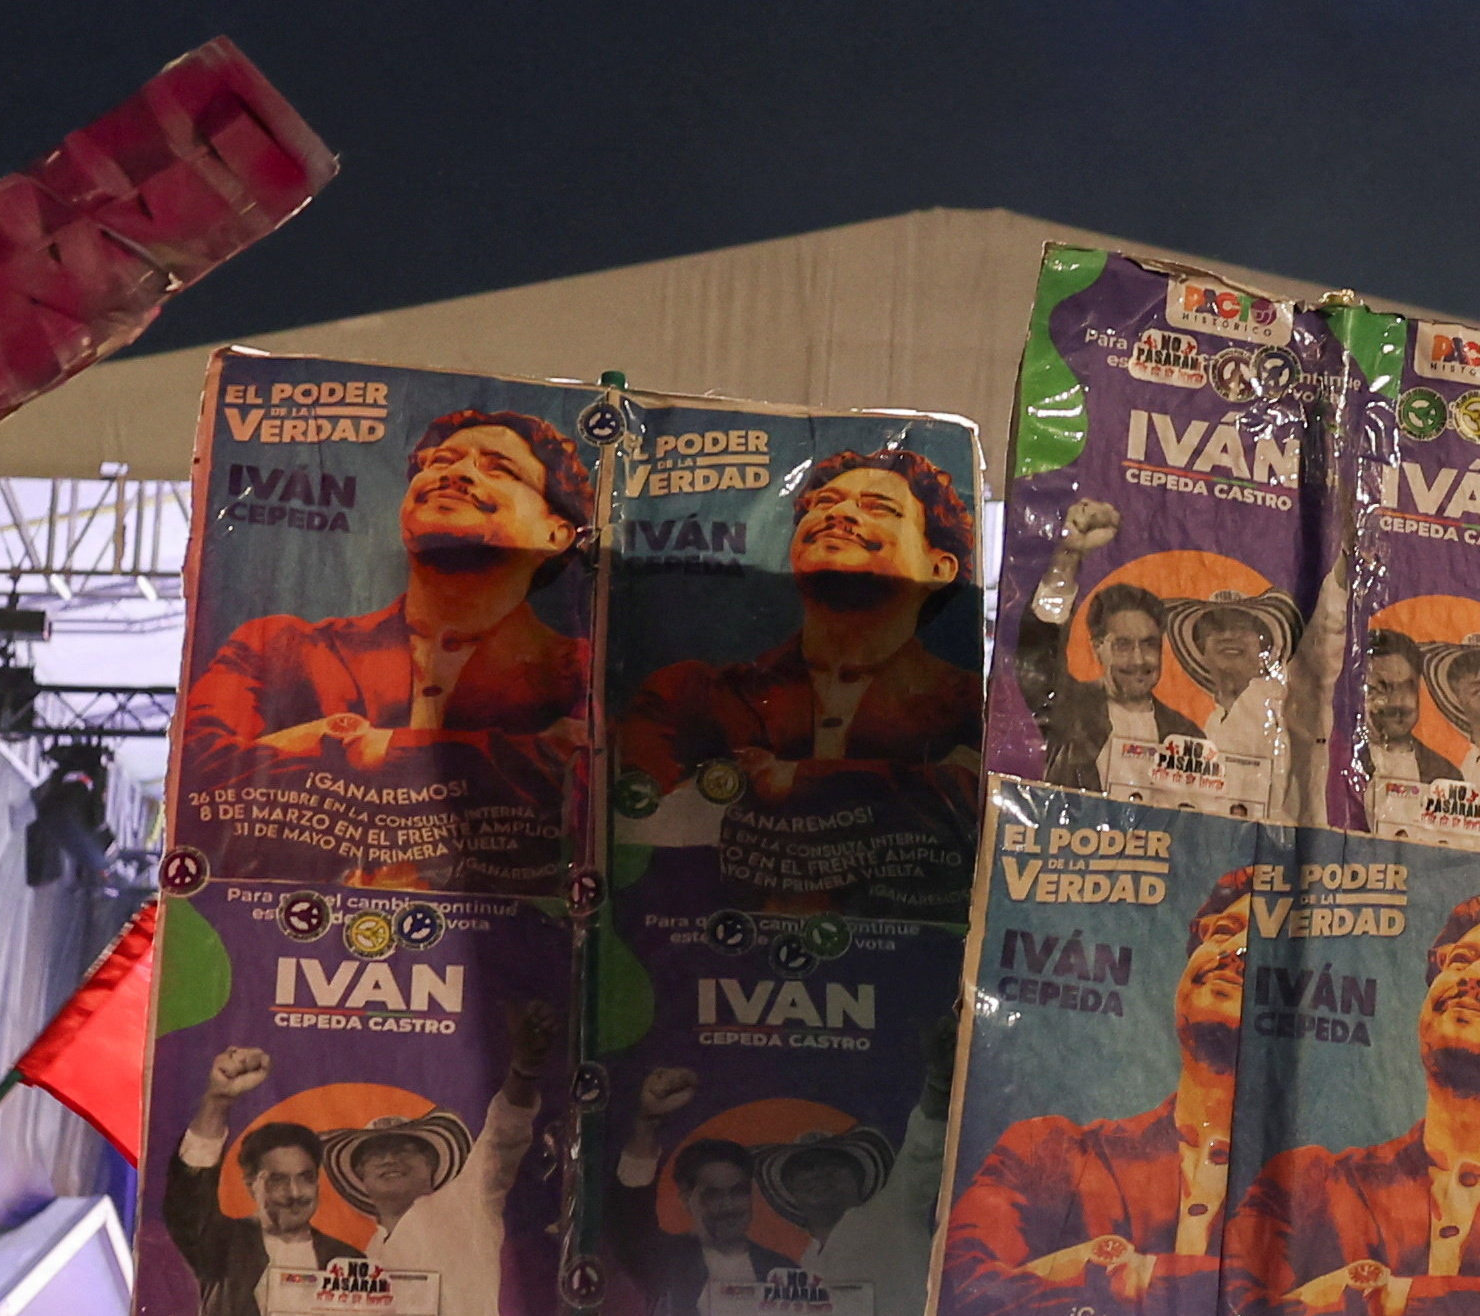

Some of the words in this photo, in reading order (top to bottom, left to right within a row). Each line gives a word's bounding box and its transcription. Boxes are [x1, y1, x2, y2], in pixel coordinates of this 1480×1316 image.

[1084, 329, 1127, 350] Para
[225, 384, 263, 405] EL
[271, 382, 388, 405] PODER
[225, 408, 385, 443] VERDAD
[656, 430, 769, 458] PODER
[229, 464, 357, 509] IVÁN
[623, 457, 770, 498] VERDAD
[1126, 468, 1207, 497] CEPEDA
[1214, 484, 1292, 511] CASTRO
[229, 504, 350, 532] CEPEDA
[628, 514, 746, 554] IVÁN
[1380, 515, 1458, 542] CEPEDA
[306, 772, 467, 805] ¡GANAREMOS!
[189, 792, 210, 806] 26
[216, 789, 237, 803] DE
[242, 788, 318, 807] OCTUBRE
[324, 795, 346, 813] EN
[349, 807, 369, 823] LA
[375, 811, 457, 828] CONSULTA
[200, 805, 212, 821] 8
[219, 803, 245, 820] DE
[252, 805, 330, 831] MARZO
[334, 820, 361, 842] EN
[368, 828, 389, 846] EL
[398, 824, 470, 846] FRENTE
[234, 823, 248, 836] 31
[255, 822, 277, 838] DE
[282, 827, 336, 850] MAYO
[339, 842, 362, 859] EN
[369, 843, 449, 863] PRIMERA
[1004, 824, 1041, 854] EL
[1049, 827, 1172, 858] PODER
[1001, 856, 1166, 905] VERDAD
[1253, 864, 1291, 892] EL
[1301, 862, 1407, 892] PODER
[227, 888, 273, 906] Para
[1252, 895, 1407, 939] VERDAD
[1001, 928, 1132, 986] IVÁN
[999, 976, 1124, 1017] CEPEDA
[1254, 962, 1377, 1017] IVÁN
[274, 1011, 362, 1031] CEPEDA
[368, 1016, 456, 1035] CASTRO
[1254, 1012, 1371, 1047] CEPEDA
[699, 1030, 781, 1048] CEPEDA
[788, 1033, 871, 1052] CASTRO
[347, 1262, 368, 1278] NO
